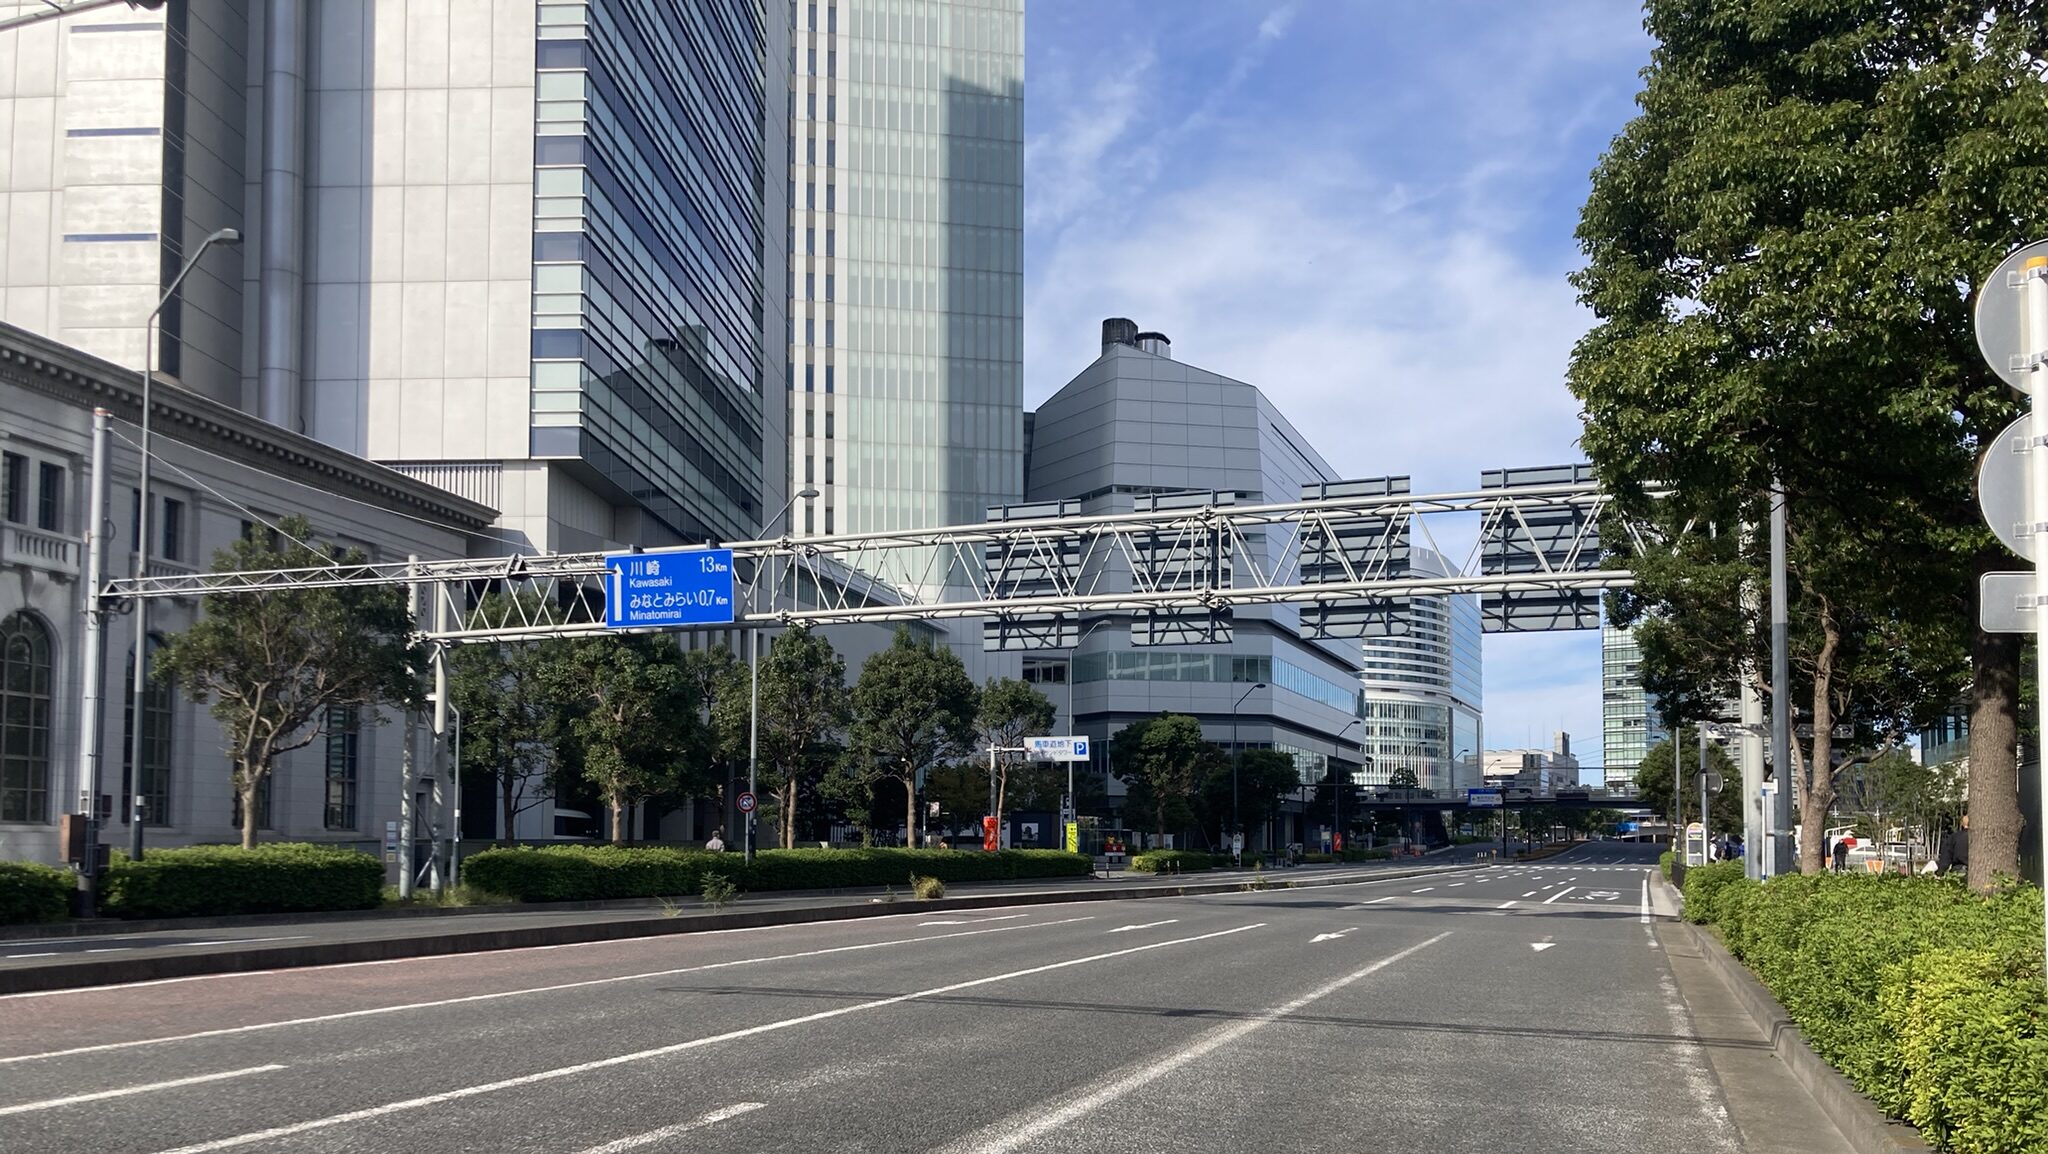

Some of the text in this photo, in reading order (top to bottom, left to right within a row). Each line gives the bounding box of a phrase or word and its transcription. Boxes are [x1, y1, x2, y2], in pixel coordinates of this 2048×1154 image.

[630, 560, 660, 576] 川崎
[629, 576, 673, 588] Kawasaki
[630, 592, 698, 609] みなとみらい
[630, 608, 682, 621] Minatomirai
